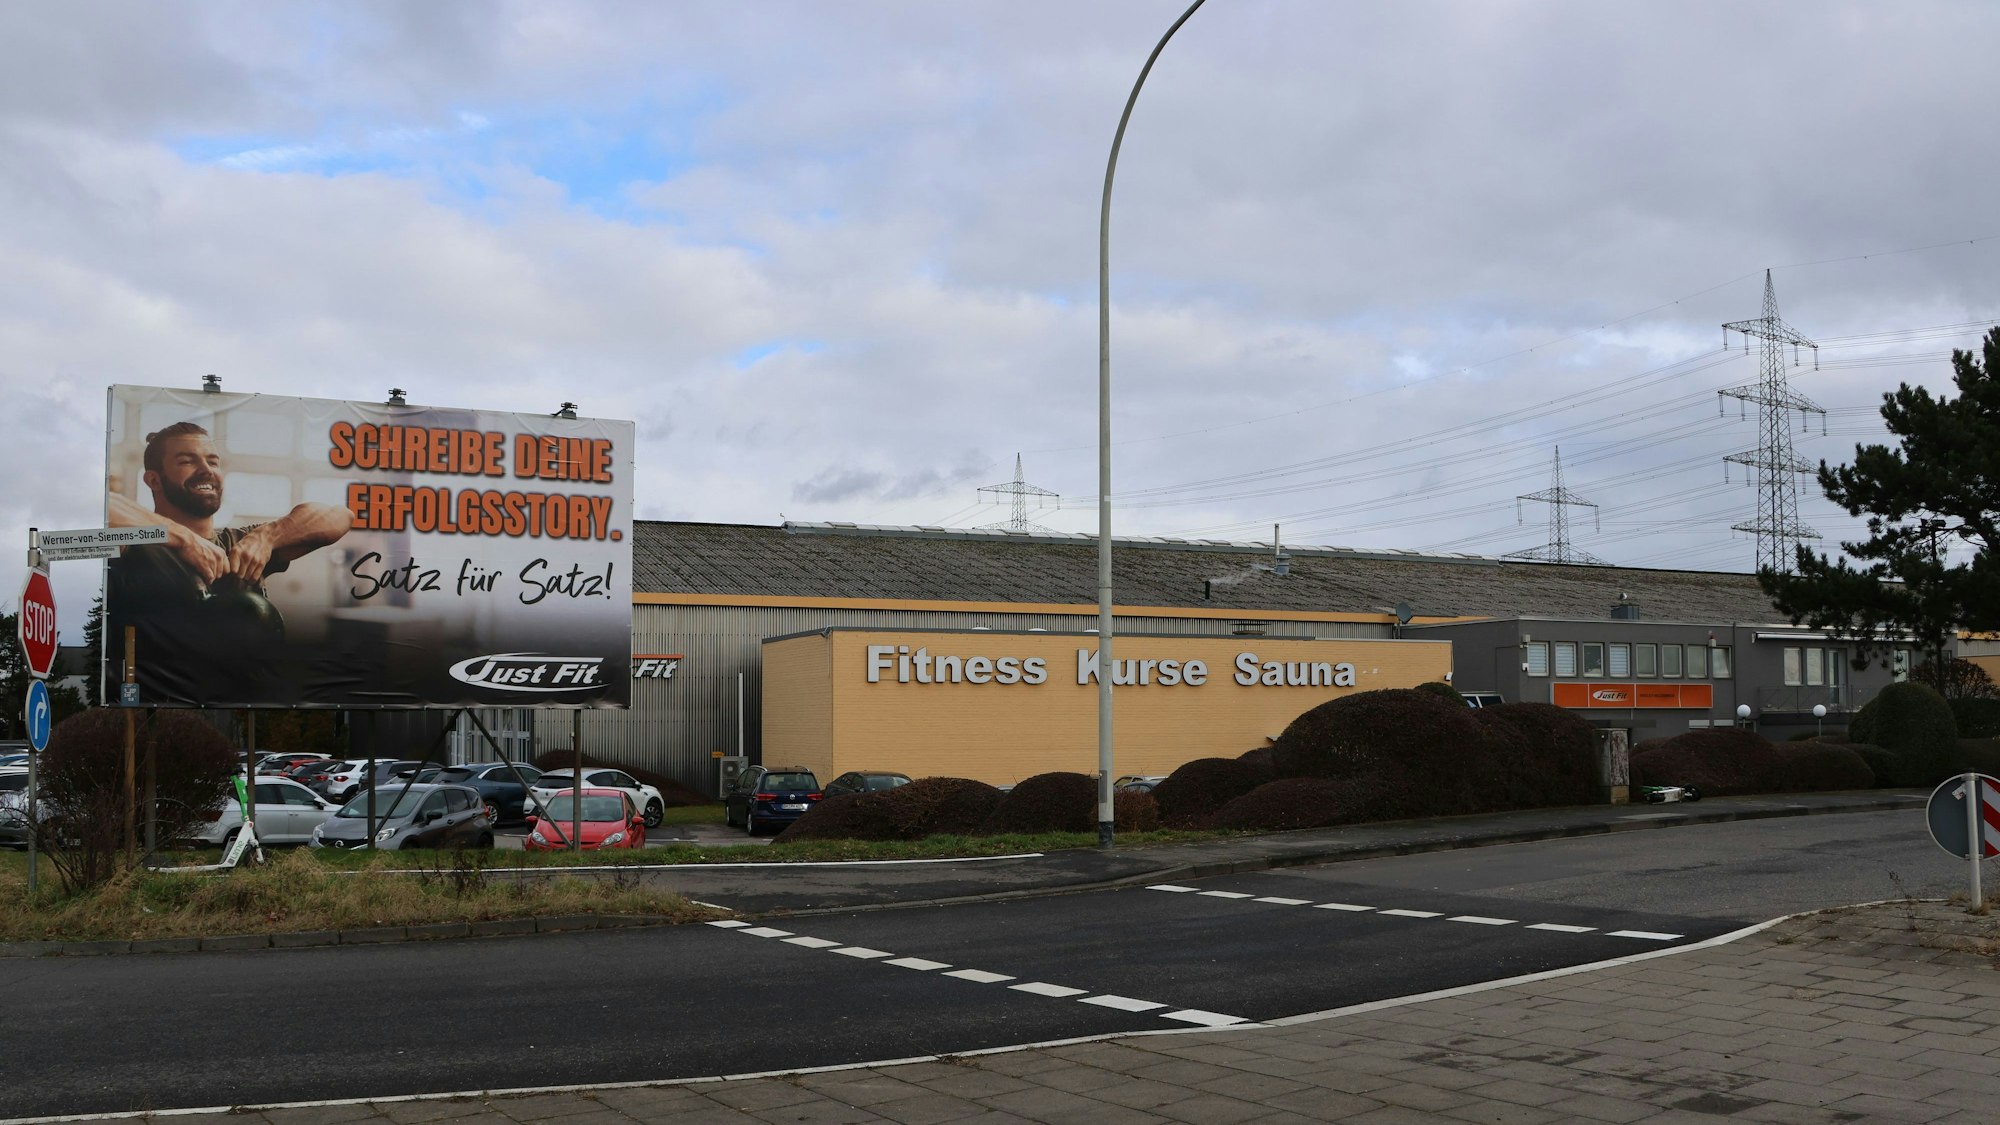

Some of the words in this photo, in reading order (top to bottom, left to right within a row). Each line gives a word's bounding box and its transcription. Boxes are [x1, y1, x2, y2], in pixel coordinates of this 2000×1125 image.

[329, 421, 505, 476] SCHREIBE
[515, 432, 613, 483] DEINE
[347, 483, 623, 541] ERFOLGSSTORY.
[42, 529, 165, 545] Werner-von-Siemens-Straße
[351, 551, 441, 600] Satz
[457, 558, 502, 595] für
[519, 558, 613, 605] Satz!
[25, 599, 54, 645] STOP
[466, 660, 547, 684] Just
[552, 663, 599, 684] Fit
[635, 659, 677, 679] Fit
[867, 645, 1048, 684] Fitness
[1077, 649, 1208, 686] Kurse
[1234, 652, 1356, 687] Sauna
[1597, 691, 1615, 699] Just
